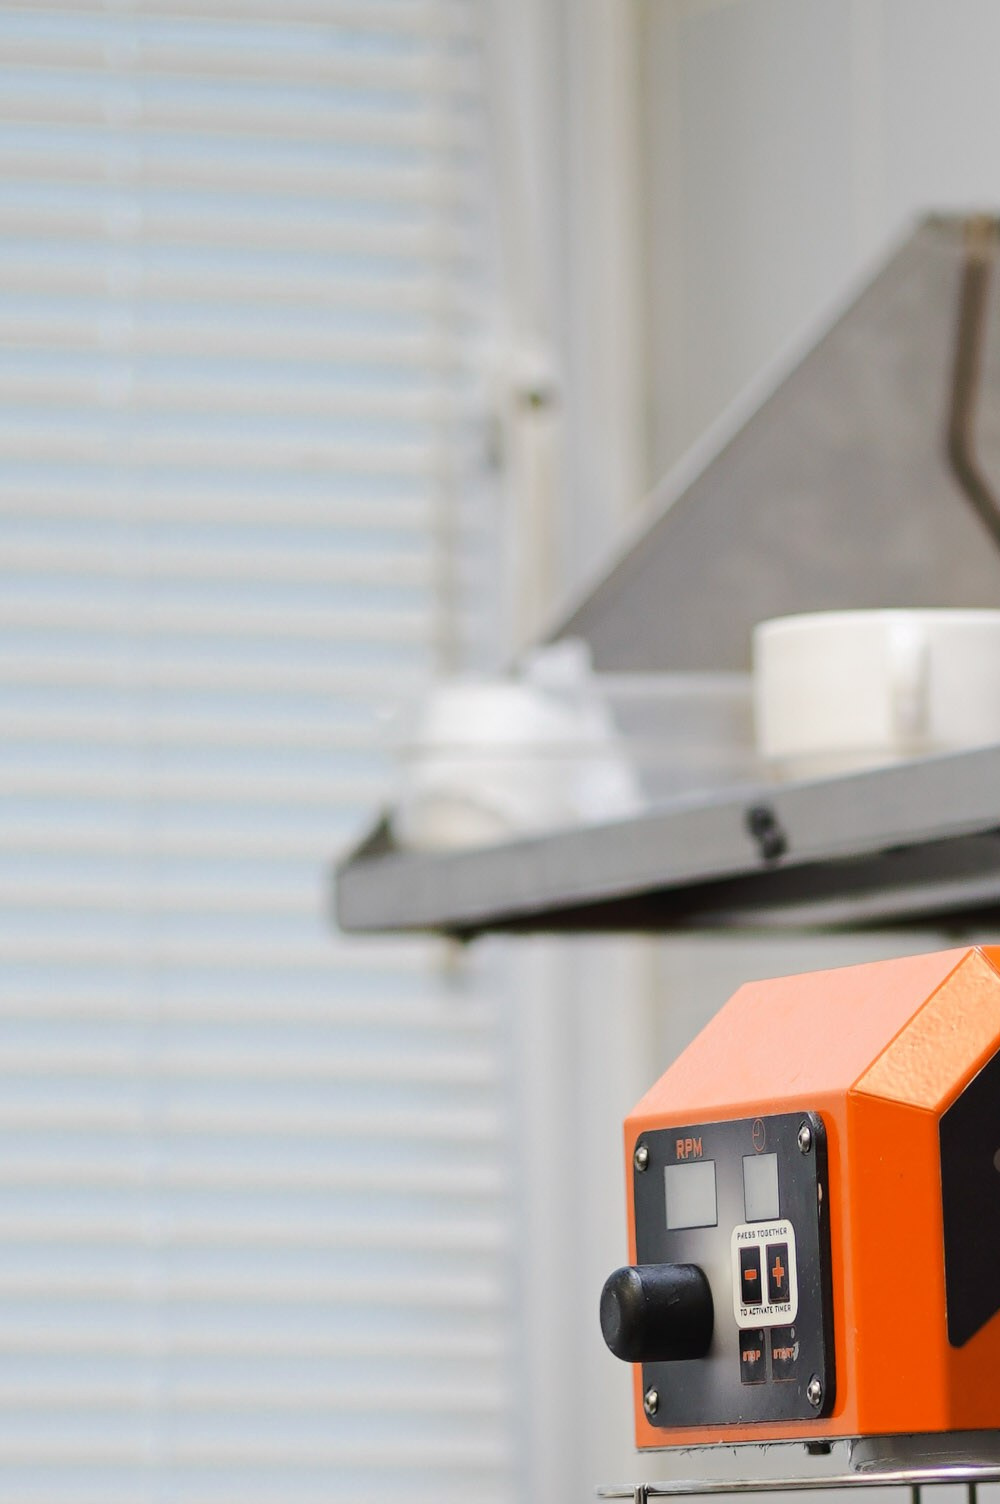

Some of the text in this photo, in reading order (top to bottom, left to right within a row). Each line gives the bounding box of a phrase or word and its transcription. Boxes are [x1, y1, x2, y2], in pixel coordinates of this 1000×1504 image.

[676, 1136, 703, 1160] RPM
[736, 1226, 788, 1241] PRESS TOGETHER
[740, 1304, 792, 1317] TO ACTIVATE TIMER
[742, 1350, 761, 1362] STOP
[773, 1347, 795, 1360] START
